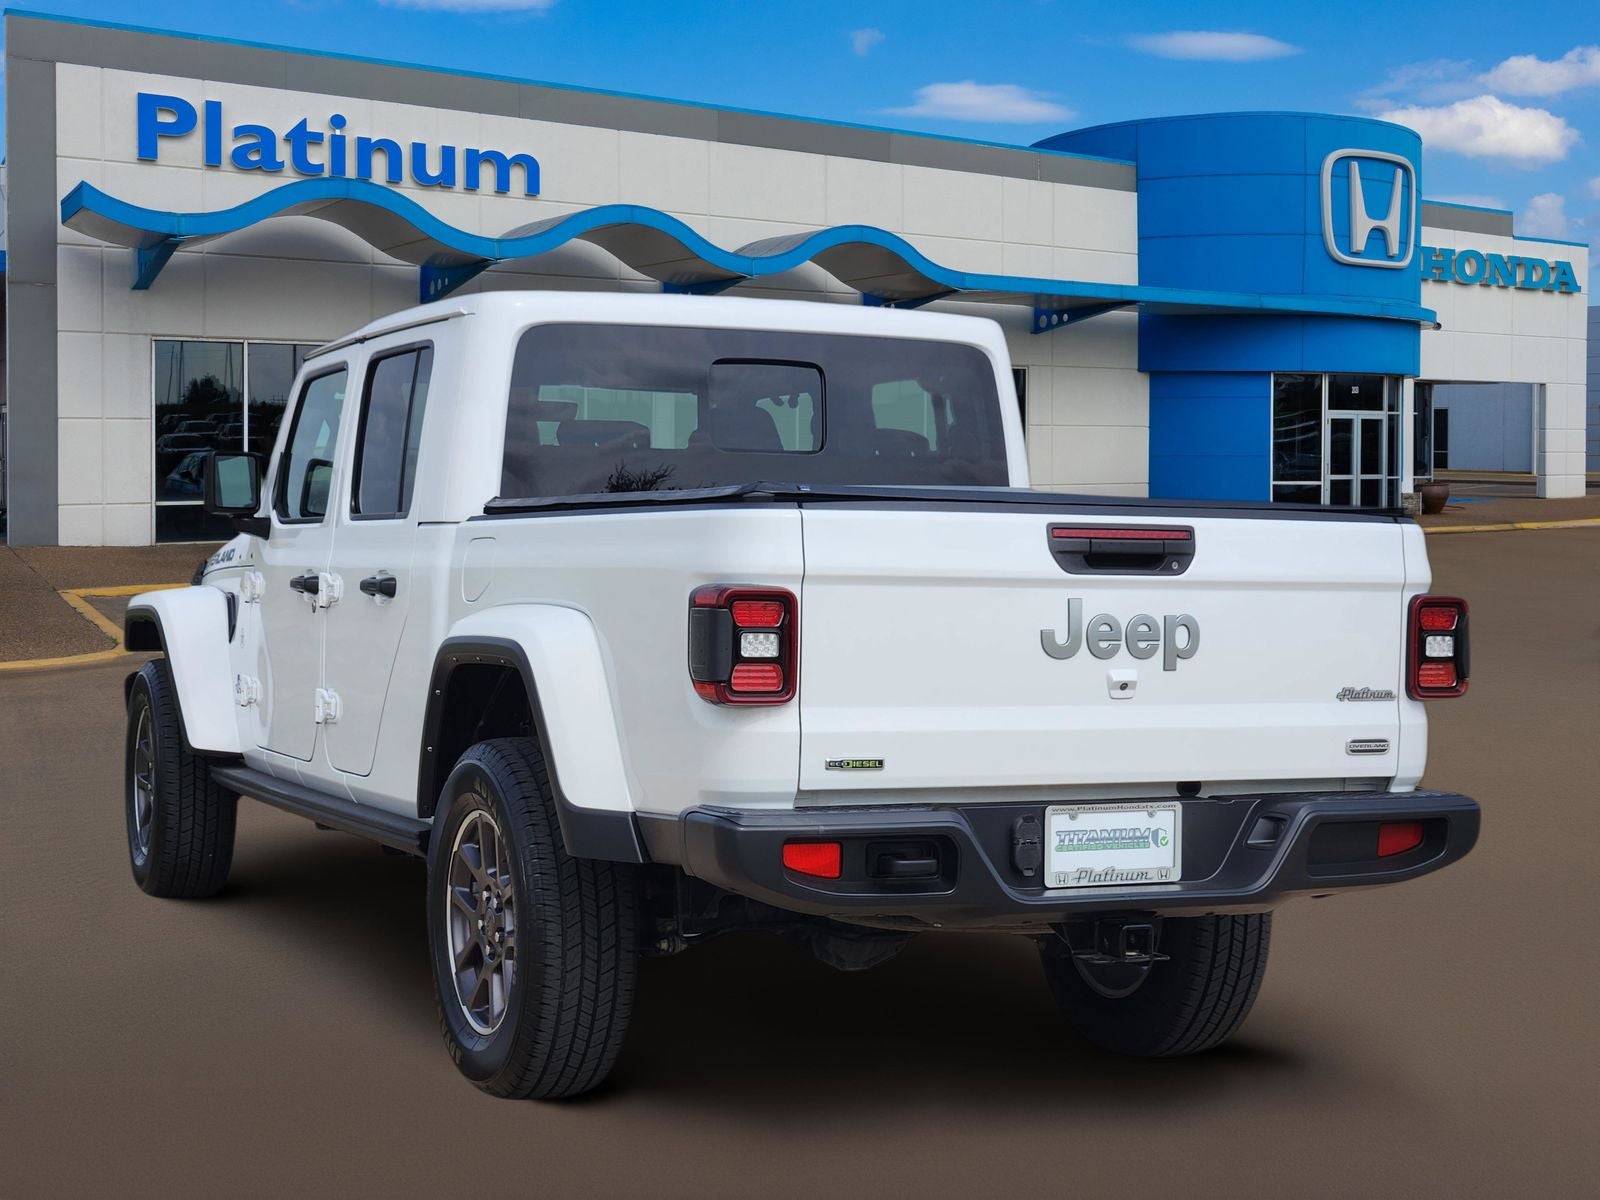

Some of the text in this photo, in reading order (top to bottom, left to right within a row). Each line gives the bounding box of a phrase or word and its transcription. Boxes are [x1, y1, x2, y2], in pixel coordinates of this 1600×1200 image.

[136, 92, 541, 196] Platinum
[1420, 246, 1582, 293] HONDA
[1040, 597, 1200, 671] Jeep
[1336, 686, 1396, 702] Platinum
[1056, 827, 1151, 844] TITANIUM
[1072, 866, 1155, 884] Platinum
